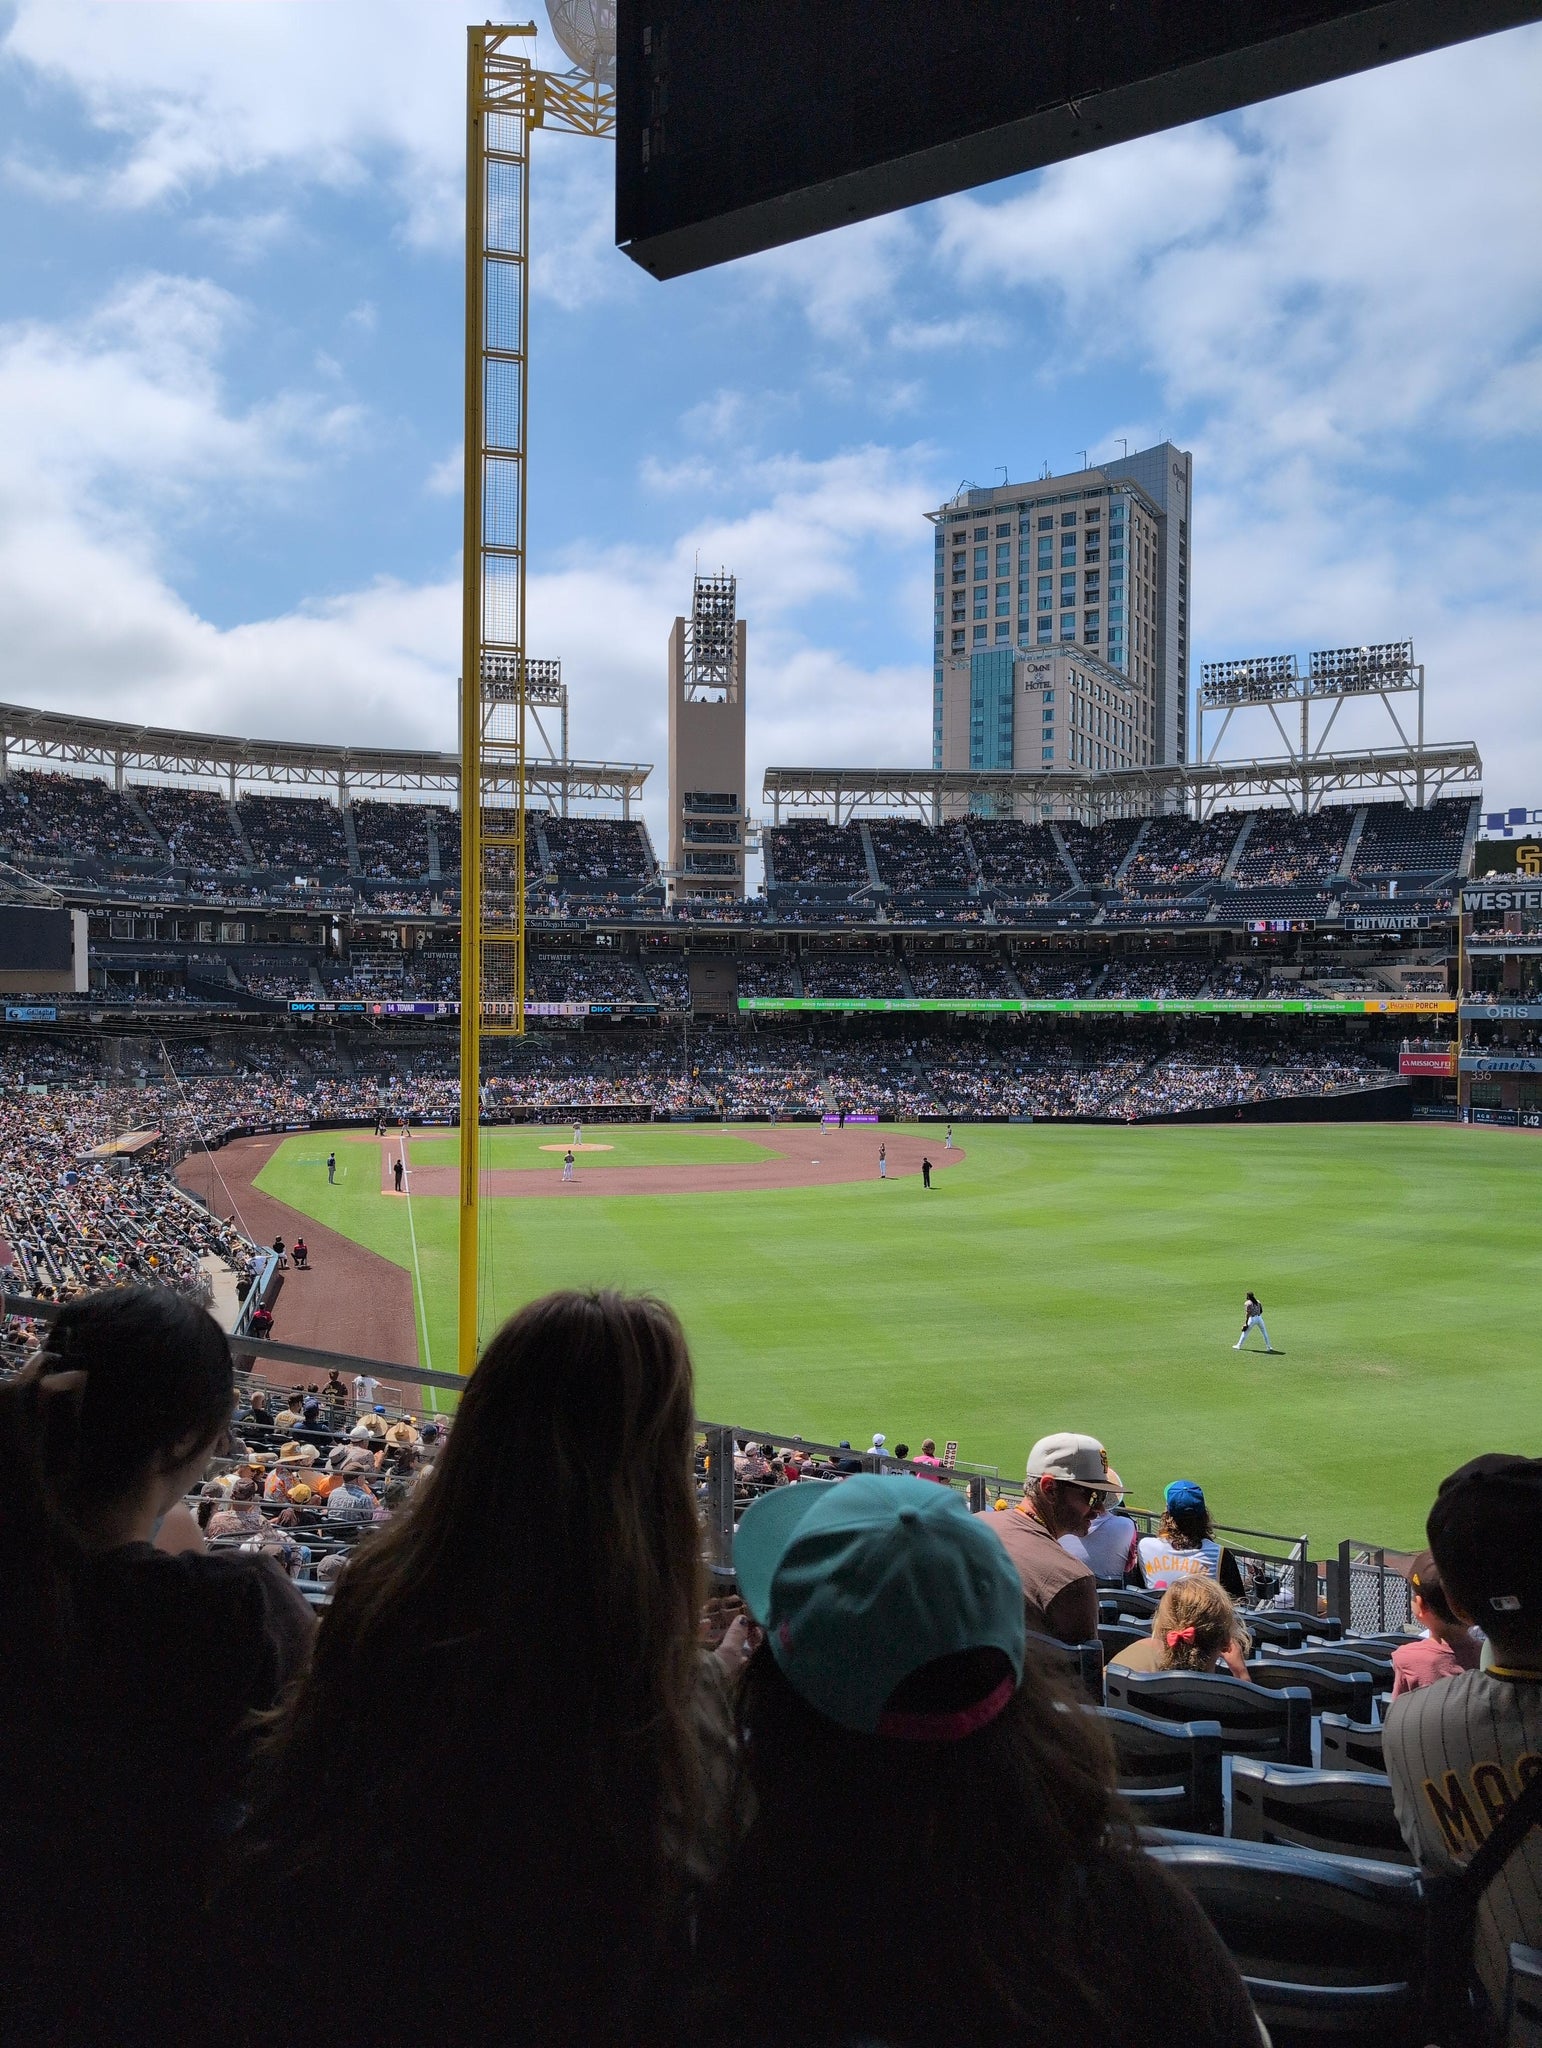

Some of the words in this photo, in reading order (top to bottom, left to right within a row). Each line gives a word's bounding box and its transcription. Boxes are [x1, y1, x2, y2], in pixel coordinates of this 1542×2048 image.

[1025, 681, 1052, 690] HOTEL
[116, 910, 164, 919] CENTER
[543, 920, 560, 928] Diego
[560, 920, 580, 928] Health
[1354, 918, 1418, 930] CUTWATER
[1487, 1006, 1528, 1018] ORIS
[1476, 1059, 1536, 1071] Canel's
[1471, 1070, 1491, 1080] 336
[1523, 1115, 1540, 1126] 342
[1145, 1555, 1210, 1577] MACHADO
